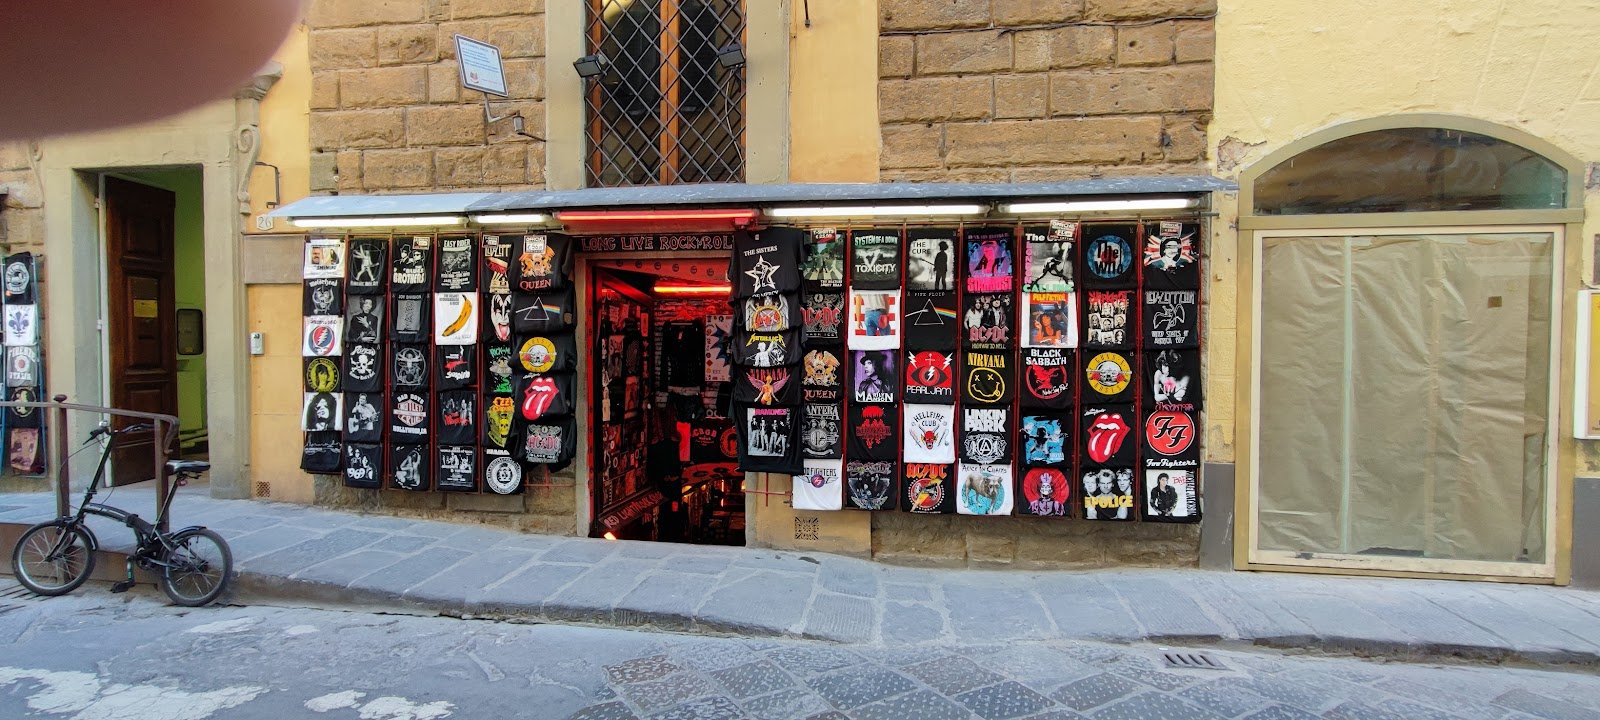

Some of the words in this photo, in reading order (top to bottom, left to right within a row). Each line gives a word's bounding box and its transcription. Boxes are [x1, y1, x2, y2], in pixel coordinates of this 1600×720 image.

[258, 216, 272, 229] 26
[582, 237, 616, 251] LONG
[621, 236, 653, 250] LIVE
[854, 235, 876, 246] SYSTEM
[1025, 233, 1046, 242] The
[744, 249, 756, 257] THE
[756, 245, 778, 254] SISTERS
[1024, 241, 1033, 284] LONDON
[855, 263, 896, 275] TOXICITY
[393, 272, 425, 284] BROTHERS
[520, 279, 552, 292] QUEEN
[969, 325, 1010, 343] AC/DC
[1031, 349, 1061, 357] BLACK
[968, 352, 1005, 368] NIRVANA
[1026, 356, 1067, 366] SABBATH
[750, 367, 787, 381] NIRVANA
[906, 385, 930, 395] PEARL
[930, 387, 952, 395] JAM
[806, 403, 840, 420] ANTERA
[913, 410, 944, 422] HELLFIRE
[965, 409, 1006, 420] LINKIN
[965, 420, 1006, 432] PARK
[692, 428, 718, 437] CBGB
[1146, 459, 1162, 467] Foo
[1161, 459, 1197, 469] Fighters
[906, 463, 948, 479] AC/DC
[1091, 495, 1134, 508] POLICE
